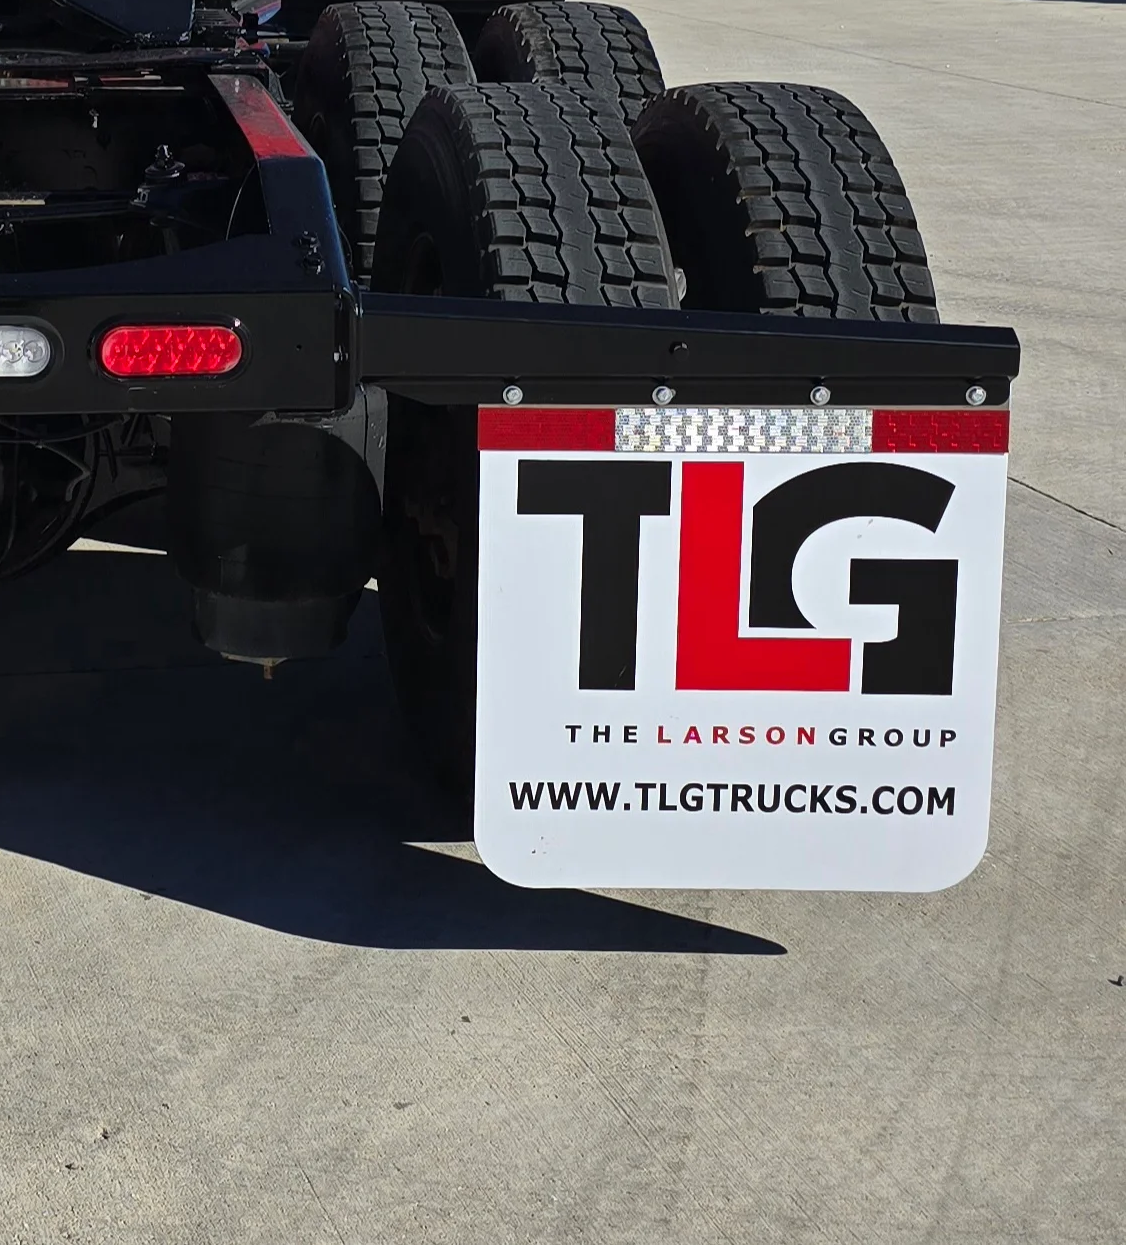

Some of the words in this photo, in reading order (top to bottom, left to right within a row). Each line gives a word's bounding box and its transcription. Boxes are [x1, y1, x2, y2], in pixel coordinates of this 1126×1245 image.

[517, 461, 959, 695] TLG
[565, 725, 638, 744] THE
[657, 725, 816, 745] LARSON
[829, 727, 957, 748] GROUP
[509, 781, 956, 816] WWW.TLGTRUCKS.COM
